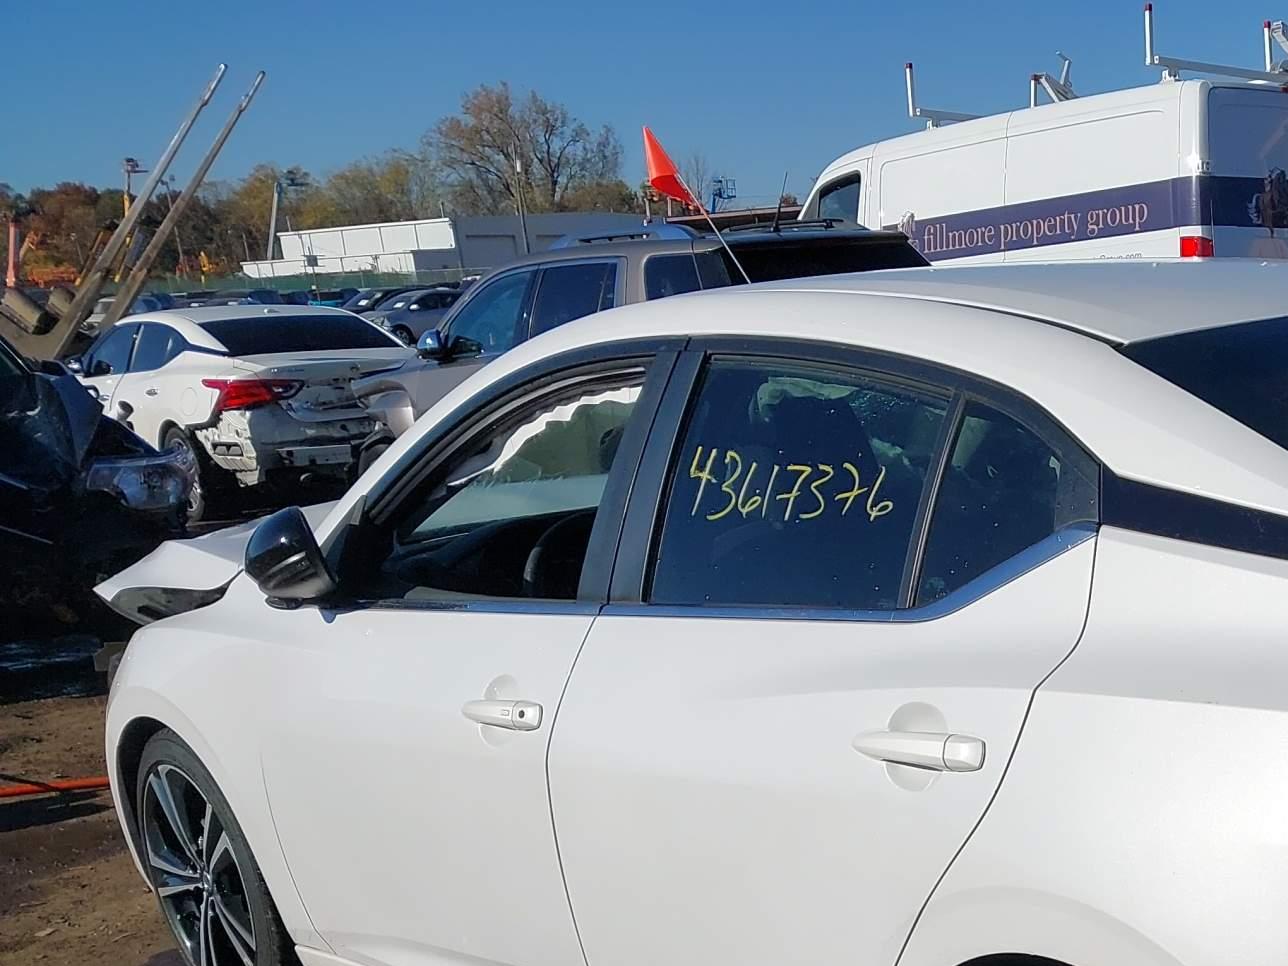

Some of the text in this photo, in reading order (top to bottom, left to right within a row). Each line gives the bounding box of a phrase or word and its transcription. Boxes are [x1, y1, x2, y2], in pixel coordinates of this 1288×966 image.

[923, 203, 1148, 254] fillmore property group
[690, 446, 893, 521] 43617376
